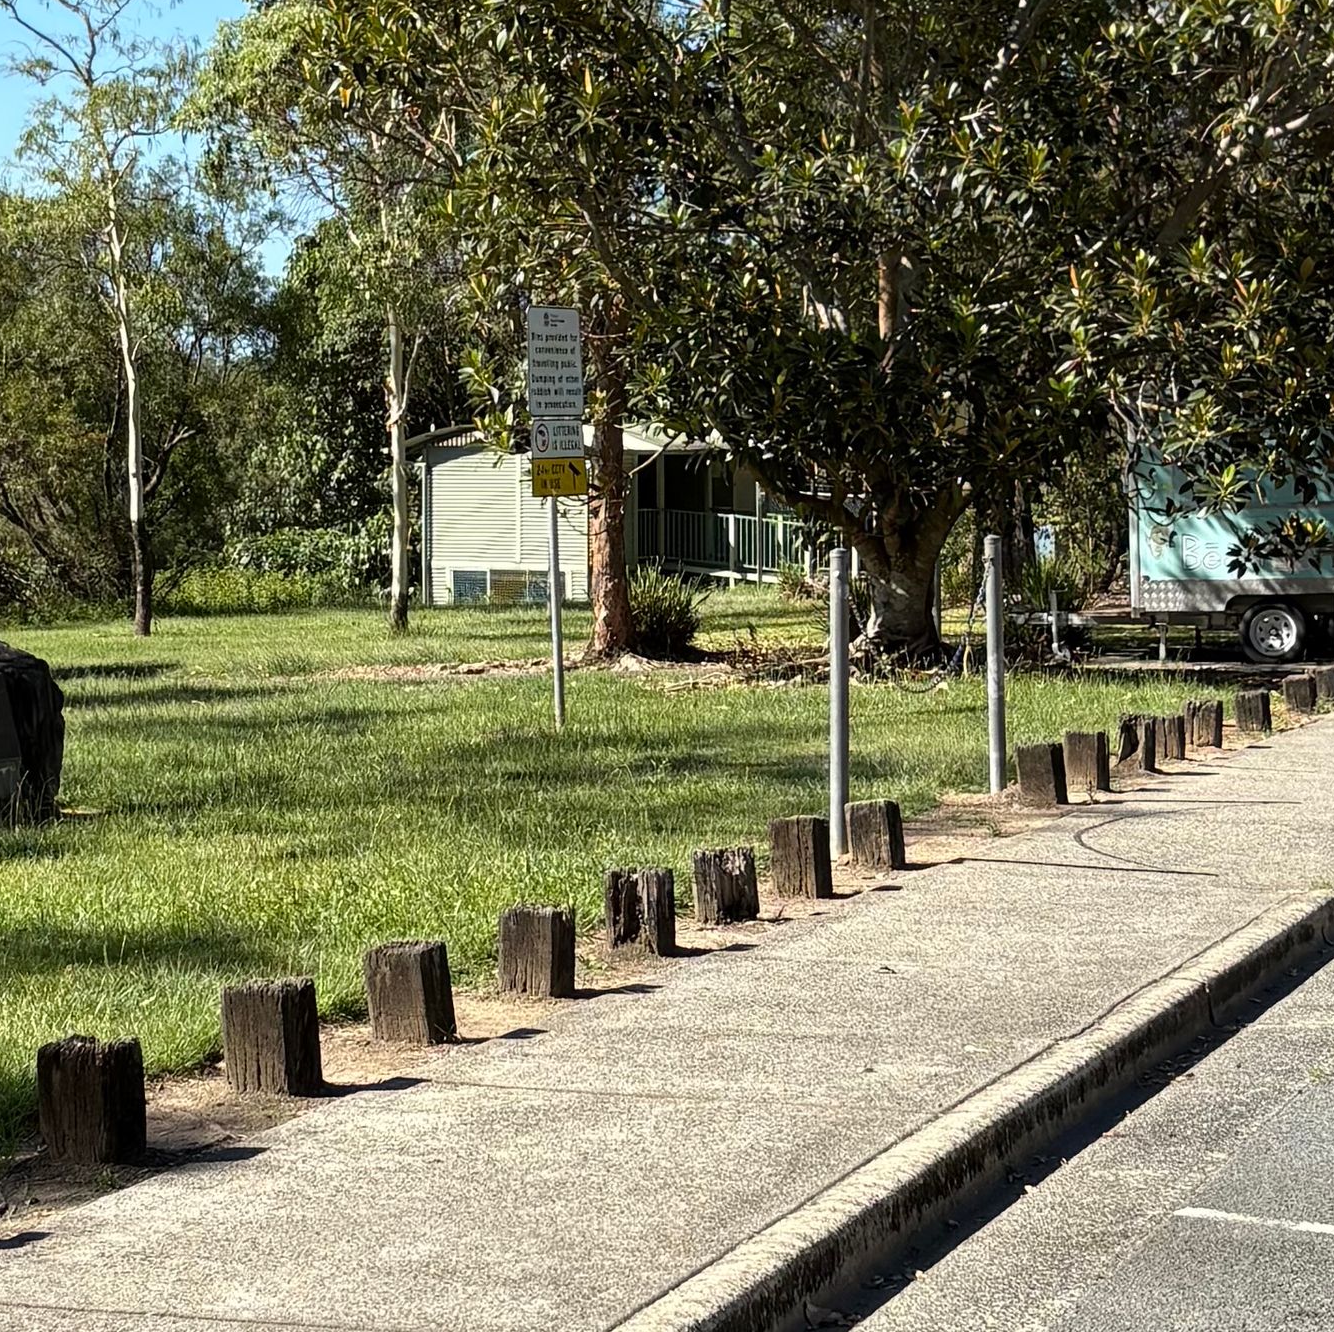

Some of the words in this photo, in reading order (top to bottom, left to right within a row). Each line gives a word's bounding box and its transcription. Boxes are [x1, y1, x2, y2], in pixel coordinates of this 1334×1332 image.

[545, 332, 568, 342] provided
[535, 346, 568, 355] convenience
[532, 374, 555, 385] Dumping
[553, 425, 580, 437] LITTERING
[552, 439, 557, 451] IS
[559, 439, 582, 451] ILLEGAL
[552, 463, 565, 474] CCTV
[541, 478, 547, 489] IN
[550, 478, 561, 489] USE
